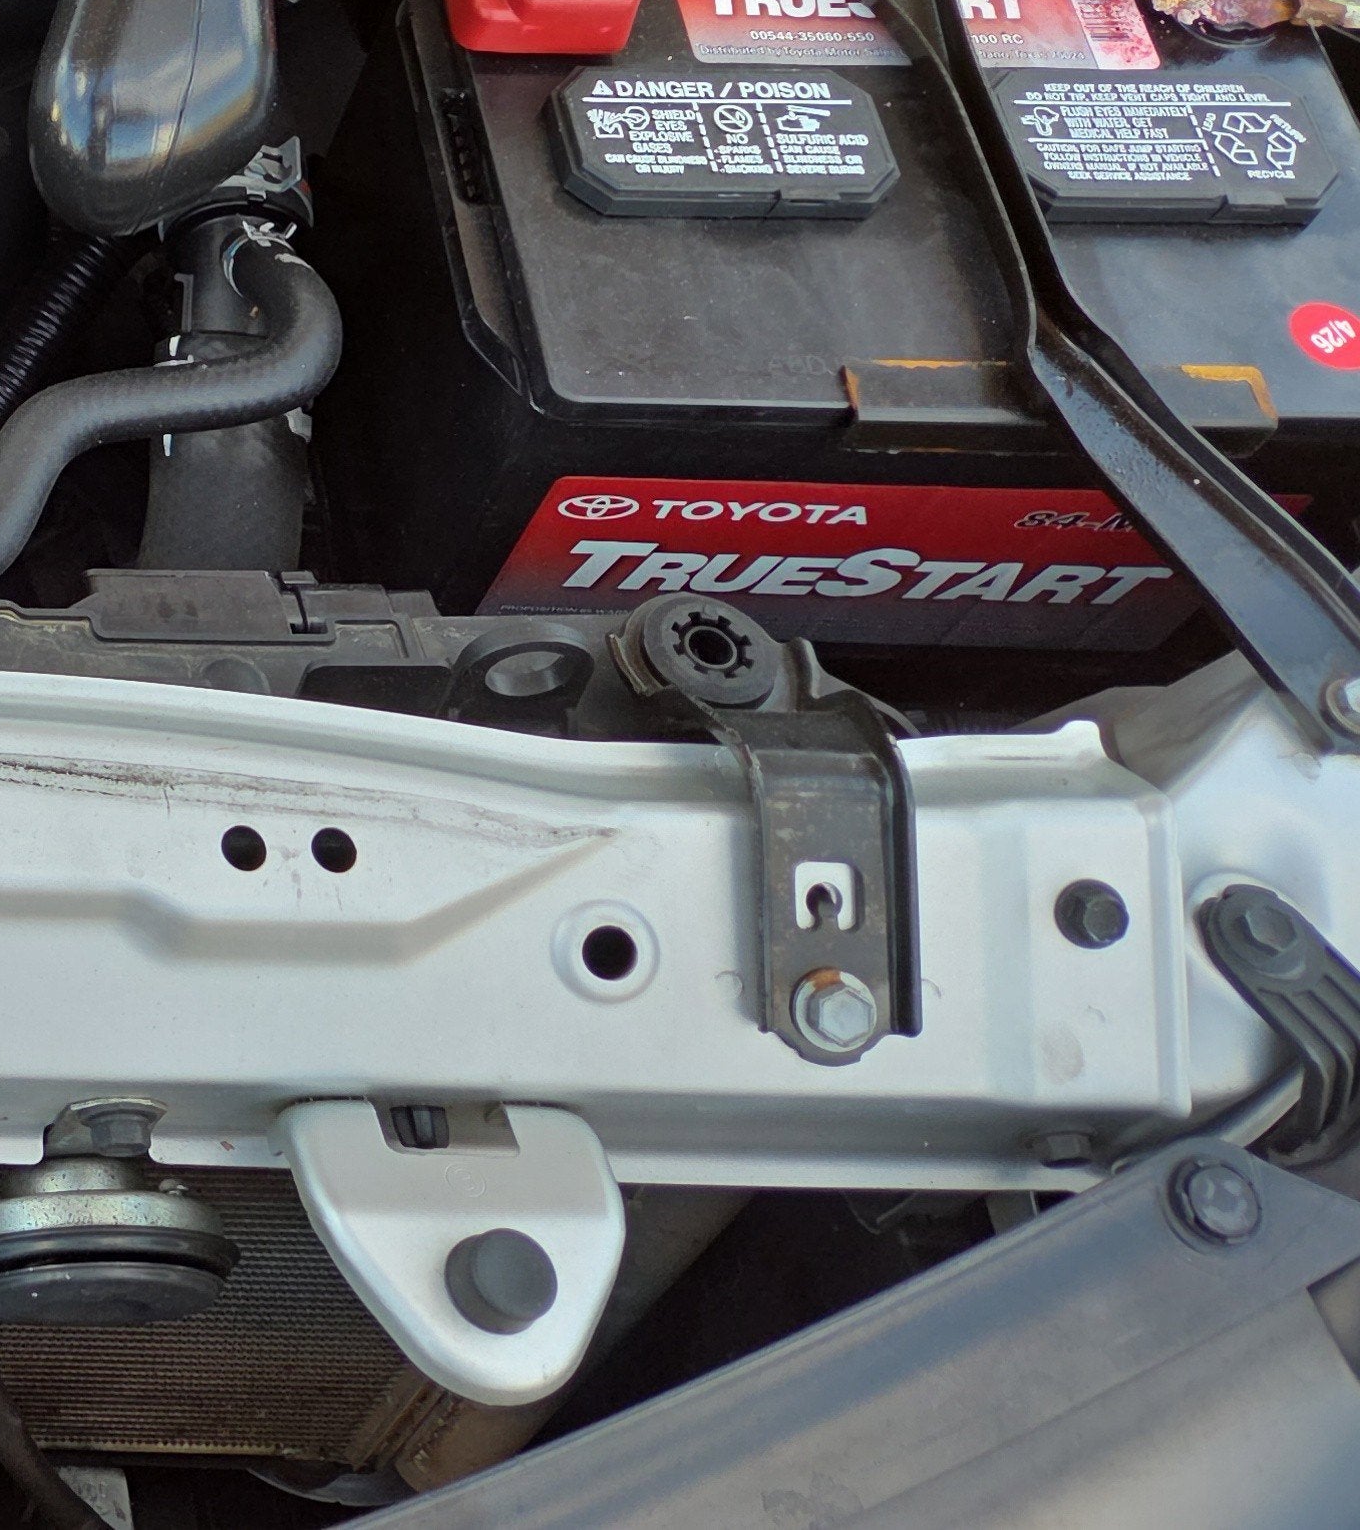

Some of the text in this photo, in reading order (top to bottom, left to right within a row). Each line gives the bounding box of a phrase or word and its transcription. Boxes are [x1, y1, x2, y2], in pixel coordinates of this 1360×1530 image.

[1000, 34, 1024, 46] RC
[782, 46, 822, 58] Toyota
[614, 80, 831, 99] DANGER / POISON
[1043, 83, 1245, 93] KEEP OUT OF THE REACH OF CHILDREN
[1026, 91, 1042, 101] DO
[1044, 92, 1066, 101] NOT
[1091, 92, 1118, 102] KEEP
[1119, 92, 1148, 102] VENT
[1150, 93, 1178, 102] CAPS
[1181, 93, 1210, 102] TIGHT
[1215, 93, 1237, 102] AND
[651, 109, 696, 121] SHIELD
[1059, 106, 1188, 117] FLUSH EYES IMMEDIATELY
[654, 120, 687, 131] EYES
[1064, 117, 1092, 128] WITH
[1132, 117, 1153, 128] GET
[1269, 113, 1307, 143] RETURN
[628, 131, 694, 142] EXPLOSIVE
[725, 133, 749, 144] NO
[1069, 128, 1169, 139] MEDICAL HELP FAST
[775, 133, 869, 146] SULFURIC ACID
[632, 142, 673, 154] GASES
[779, 145, 803, 154] CAN
[1080, 144, 1100, 153] FOR
[1101, 144, 1127, 153] SAFE
[1155, 144, 1201, 153] STARTING
[1043, 152, 1081, 162] FOLLOW
[1082, 153, 1150, 162] INSTRUCTIONS
[1164, 153, 1202, 162] VEHICLE
[1246, 170, 1296, 179] RECYCLE
[1310, 319, 1356, 354] 4/26
[652, 499, 868, 525] TOYOTA
